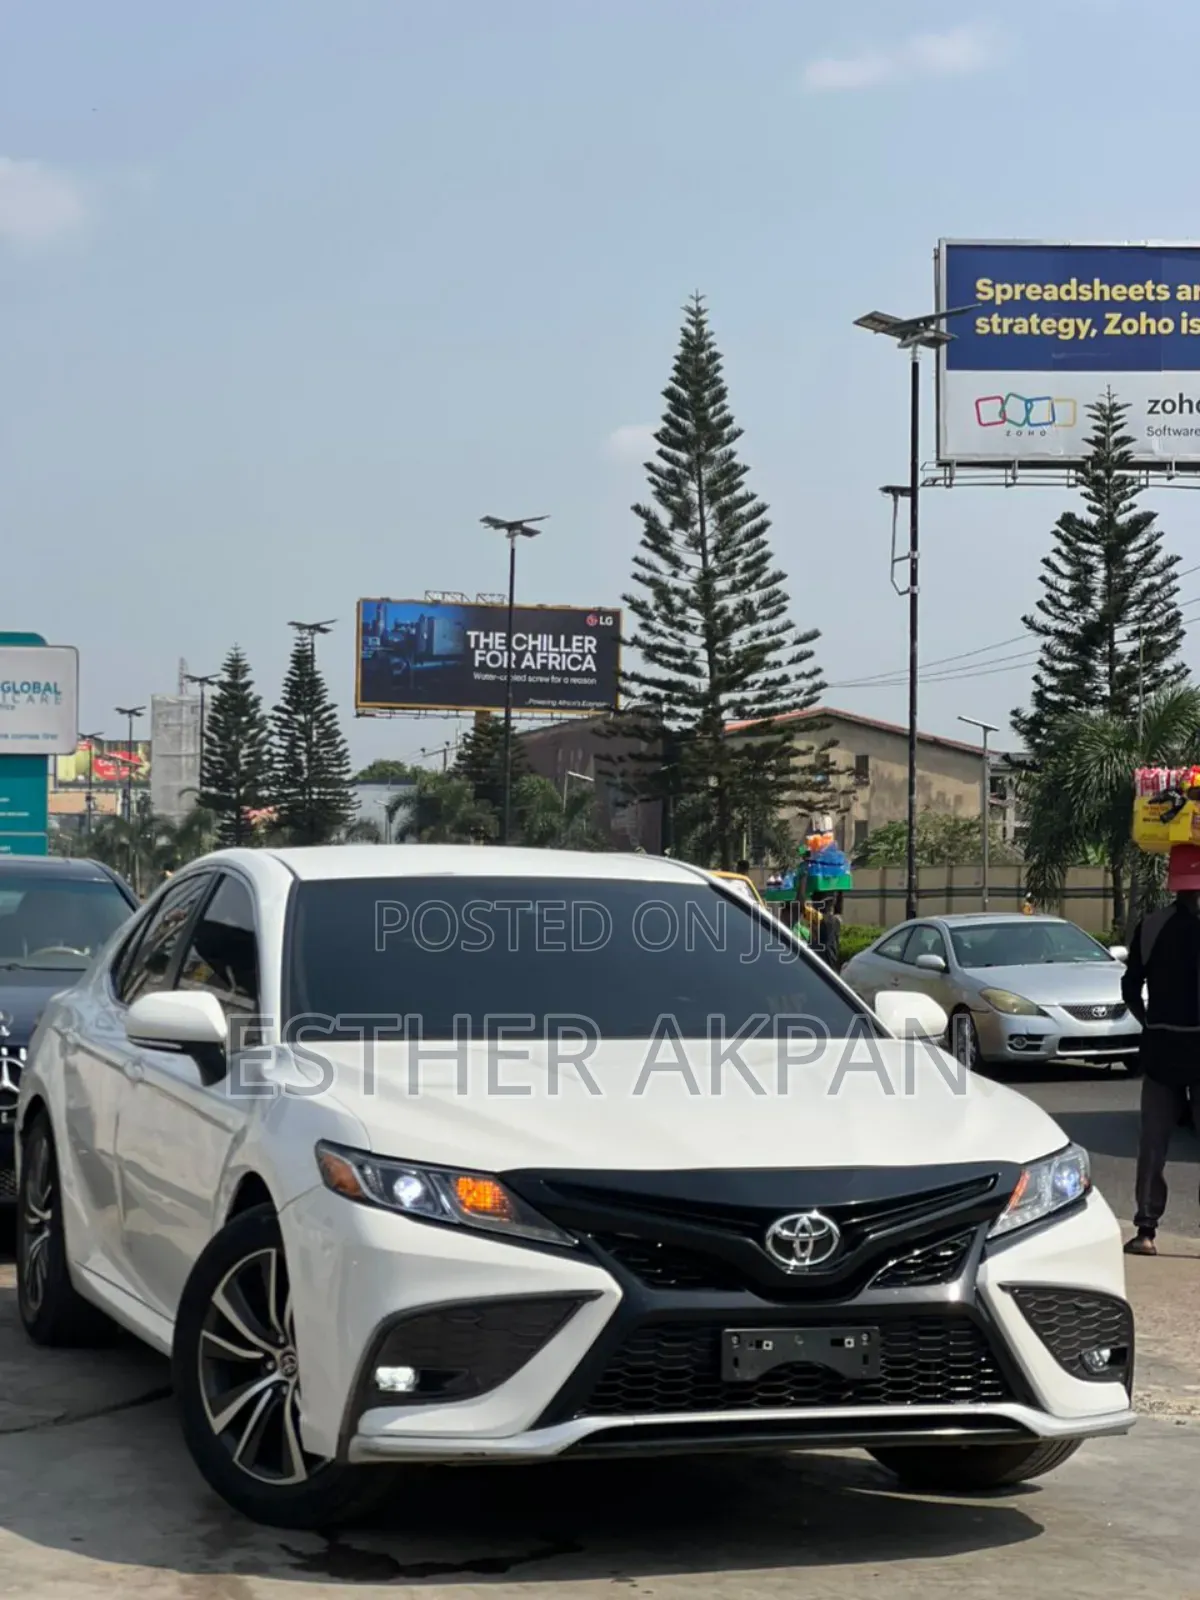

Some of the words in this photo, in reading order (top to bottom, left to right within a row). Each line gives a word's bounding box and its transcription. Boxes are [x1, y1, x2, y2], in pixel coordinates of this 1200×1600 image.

[975, 277, 1171, 305] Spreadsheets
[975, 312, 1098, 340] strategy,
[1104, 311, 1175, 335] Zoho
[1181, 311, 1200, 335] is
[599, 615, 614, 626] LG
[466, 630, 507, 650] THE
[511, 632, 597, 654] CHILLER
[474, 649, 516, 669] FOR
[520, 651, 597, 672] AFRICA
